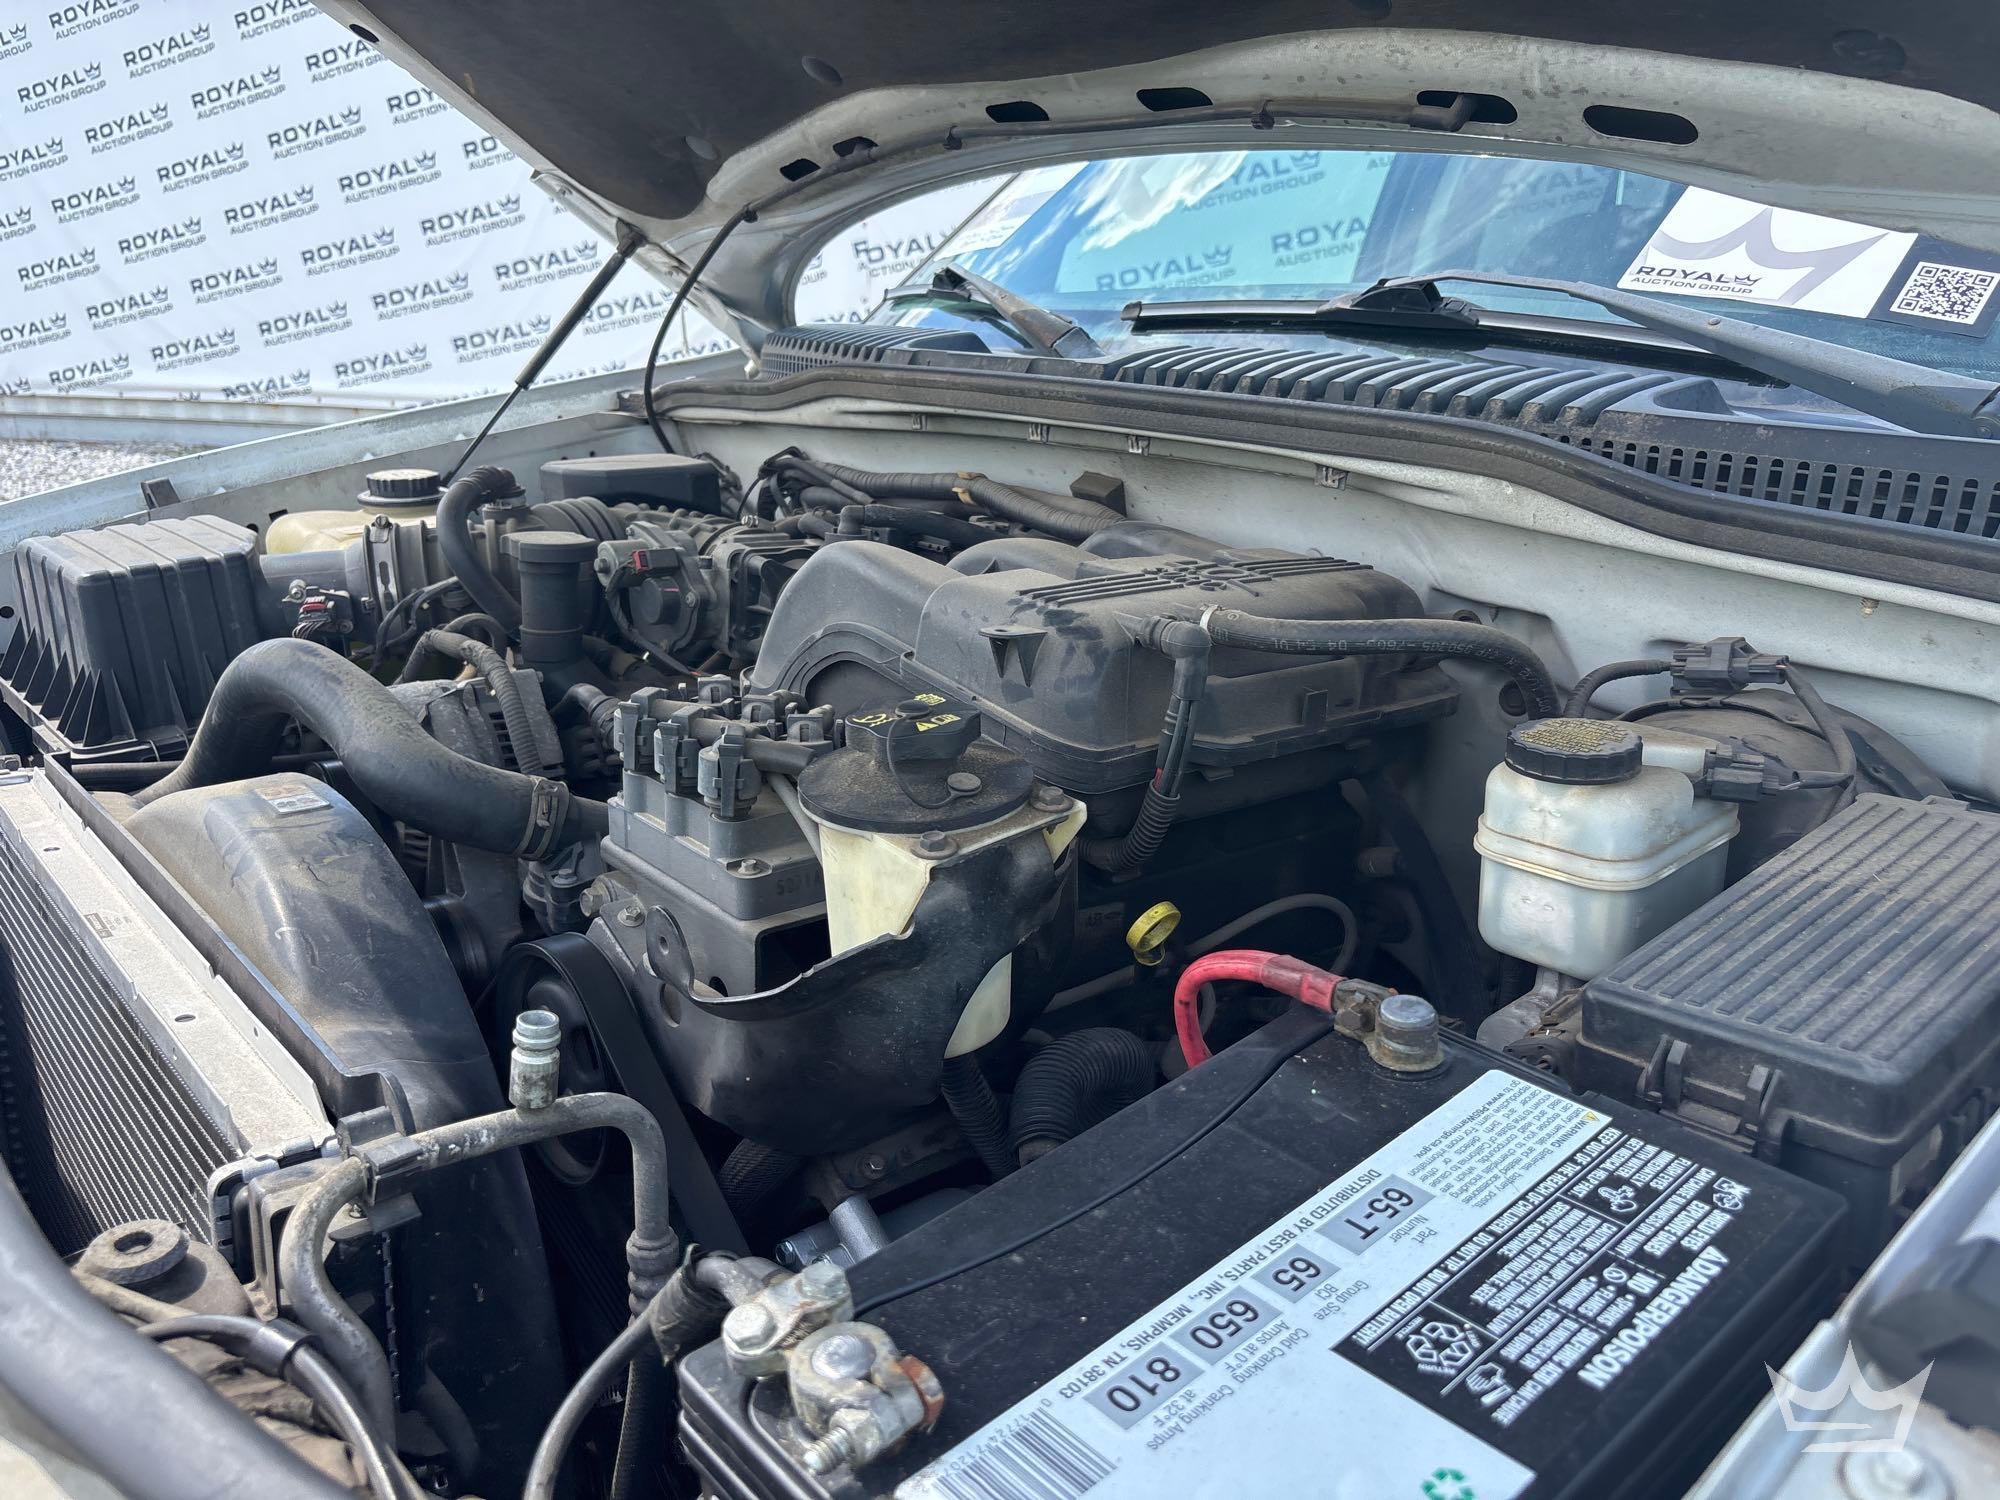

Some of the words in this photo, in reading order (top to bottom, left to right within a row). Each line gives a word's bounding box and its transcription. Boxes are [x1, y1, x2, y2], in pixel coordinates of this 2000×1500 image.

[123, 31, 193, 67] ROYAL
[17, 70, 86, 102] ROYAL
[191, 74, 262, 109] ROYAL
[85, 110, 151, 143] ROYAL
[267, 114, 340, 149] ROYAL
[156, 150, 227, 182] ROYAL
[338, 159, 417, 192] ROYAL
[1261, 171, 1325, 194] GROUP
[51, 183, 121, 213] ROYAL
[224, 192, 297, 225] ROYAL
[420, 201, 499, 235] ROYAL
[118, 224, 186, 254] ROYAL
[1271, 217, 1367, 254] ROYA
[301, 234, 376, 266] ROYAL
[18, 253, 82, 282] ROYAL
[190, 264, 260, 294] ROYAL
[495, 254, 577, 281] ROYAL
[1637, 266, 1733, 283] ROYAL
[372, 280, 450, 310] ROYAL
[1631, 277, 1698, 289] AUCTION
[1699, 284, 1753, 294] GROUP
[86, 291, 153, 320] ROYAL
[258, 308, 330, 337] ROYAL
[151, 333, 218, 361] ROYAL
[454, 322, 531, 351] ROYAL
[49, 358, 112, 386] ROYAL
[335, 350, 409, 378] ROYAL
[1493, 1122, 1517, 1137] State
[1549, 1118, 1589, 1148] WARNING
[1594, 1126, 1623, 1145] KEEP
[1456, 1141, 1492, 1166] California
[1580, 1140, 1606, 1156] OUT
[1622, 1137, 1645, 1151] GET
[1634, 1144, 1659, 1160] WITH
[1555, 1160, 1581, 1177] THE
[1570, 1152, 1592, 1164] OF
[1598, 1147, 1634, 1172] MEDICAL
[1612, 1156, 1645, 1179] WATER.
[1628, 1150, 1675, 1186] IMMEDIATELY
[1662, 1156, 1691, 1176] FLUSH
[1533, 1172, 1568, 1195] REACH
[1583, 1167, 1609, 1184] HELP
[1647, 1172, 1673, 1189] EYES
[1674, 1177, 1705, 1198] CAUSE
[1692, 1167, 1716, 1182] CAN
[1307, 1168, 1381, 1220] DISTRIBUTED
[1522, 1191, 1544, 1204] OF
[1566, 1180, 1594, 1199] FAST.
[1336, 1185, 1417, 1240] 65-T
[1484, 1199, 1534, 1236] CHILDREN.
[1535, 1200, 1570, 1226] SERVICE
[1550, 1207, 1586, 1233] MANUAL
[1643, 1193, 1687, 1227] BLINDNESS
[1662, 1199, 1710, 1236] EXPLOSIVE
[1290, 1216, 1315, 1232] BY
[1386, 1214, 1428, 1243] Number
[1410, 1226, 1437, 1244] Part
[1541, 1227, 1562, 1241] OR
[1548, 1214, 1601, 1256] INSTRUCTIONS
[1634, 1222, 1656, 1235] OR
[1260, 1228, 1297, 1253] BEST
[1453, 1241, 1482, 1260] NOT
[1470, 1231, 1494, 1246] DO
[1495, 1221, 1545, 1259] ASSISTANCE.
[1521, 1242, 1545, 1258] NOT
[1534, 1236, 1552, 1247] IF
[1611, 1230, 1646, 1256] INJURY
[1641, 1230, 1678, 1256] GASES
[1678, 1228, 1710, 1250] EYES
[1216, 1249, 1267, 1284] PARTS,
[1439, 1254, 1465, 1272] TIP.
[1540, 1251, 1558, 1263] IN
[1545, 1259, 1576, 1281] JUMP
[1564, 1248, 1589, 1265] FOR
[1267, 1254, 1325, 1293] 65
[1424, 1268, 1449, 1285] DO
[1514, 1258, 1550, 1285] VEHICLE
[1623, 1271, 1659, 1295] NO
[1186, 1278, 1225, 1305] INC.,
[1313, 1282, 1339, 1300] BCI
[1332, 1278, 1370, 1305] Group
[1410, 1278, 1436, 1296] NOT
[1468, 1282, 1498, 1303] SEEK
[1486, 1280, 1526, 1310] OWNERS
[1555, 1277, 1597, 1309] SMOKING
[1311, 1301, 1342, 1322] Size
[1389, 1289, 1422, 1313] OPEN
[1576, 1287, 1615, 1317] FLAMES
[1594, 1295, 1634, 1327] SPARKS
[1119, 1301, 1192, 1354] MEMPHIS,
[1184, 1296, 1264, 1352] 650
[1350, 1307, 1401, 1345] BATTERY!
[1484, 1303, 1525, 1335] FOLLOW
[1522, 1307, 1562, 1338] SEVERE
[1253, 1319, 1291, 1347] Amps
[1277, 1326, 1310, 1350] Cold
[1497, 1331, 1536, 1361] BURNS
[1530, 1317, 1581, 1359] BLINDNESS
[1100, 1350, 1126, 1369] TN
[1240, 1342, 1261, 1356] at
[1517, 1352, 1543, 1370] OR
[1550, 1327, 1600, 1368] SULFURIC
[1219, 1351, 1249, 1373] 0°F
[1230, 1343, 1285, 1385] Cranking
[1531, 1360, 1565, 1386] ACID
[1056, 1363, 1107, 1400] 38103
[1101, 1353, 1185, 1415] 810
[1514, 1378, 1546, 1402] CAN
[1177, 1381, 1236, 1426] Cranking
[1178, 1388, 1199, 1404] at
[1489, 1393, 1530, 1426] CAUSE
[1144, 1420, 1186, 1453] Amps
